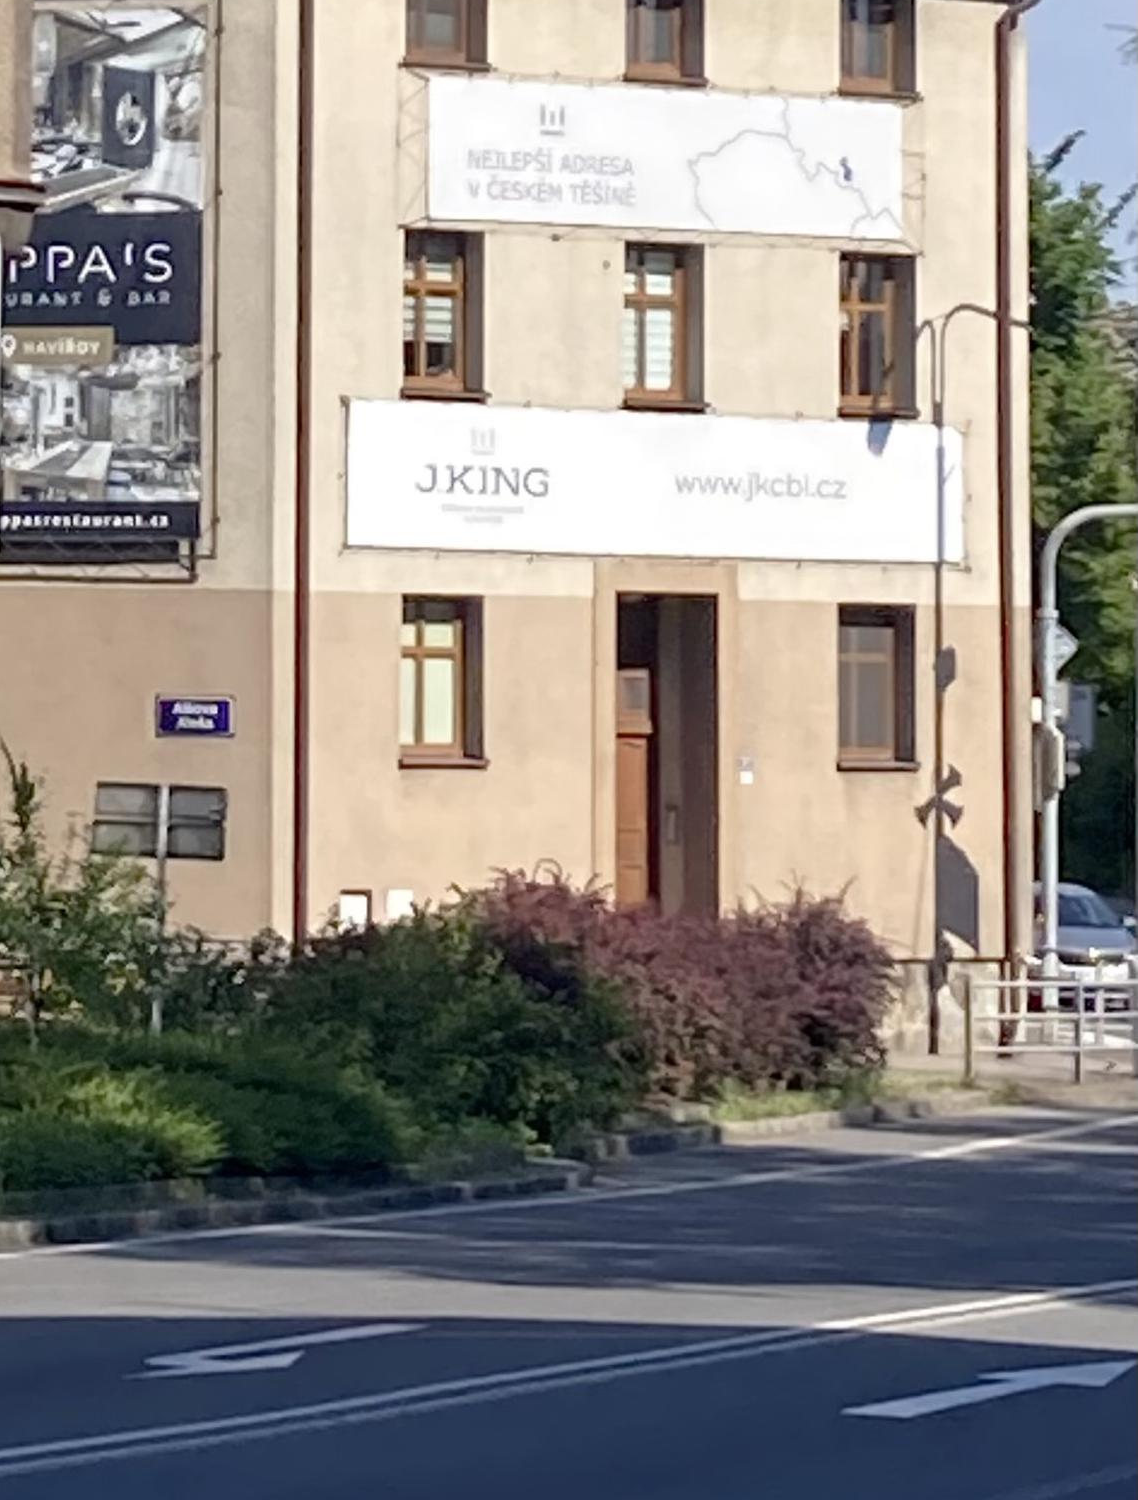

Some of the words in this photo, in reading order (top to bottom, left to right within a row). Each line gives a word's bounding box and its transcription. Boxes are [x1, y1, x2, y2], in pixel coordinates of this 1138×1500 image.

[559, 154, 635, 176] ADRESA
[468, 180, 480, 198] V
[8, 242, 174, 284] PPA'S
[5, 290, 82, 307] URANT
[126, 289, 171, 306] BAR
